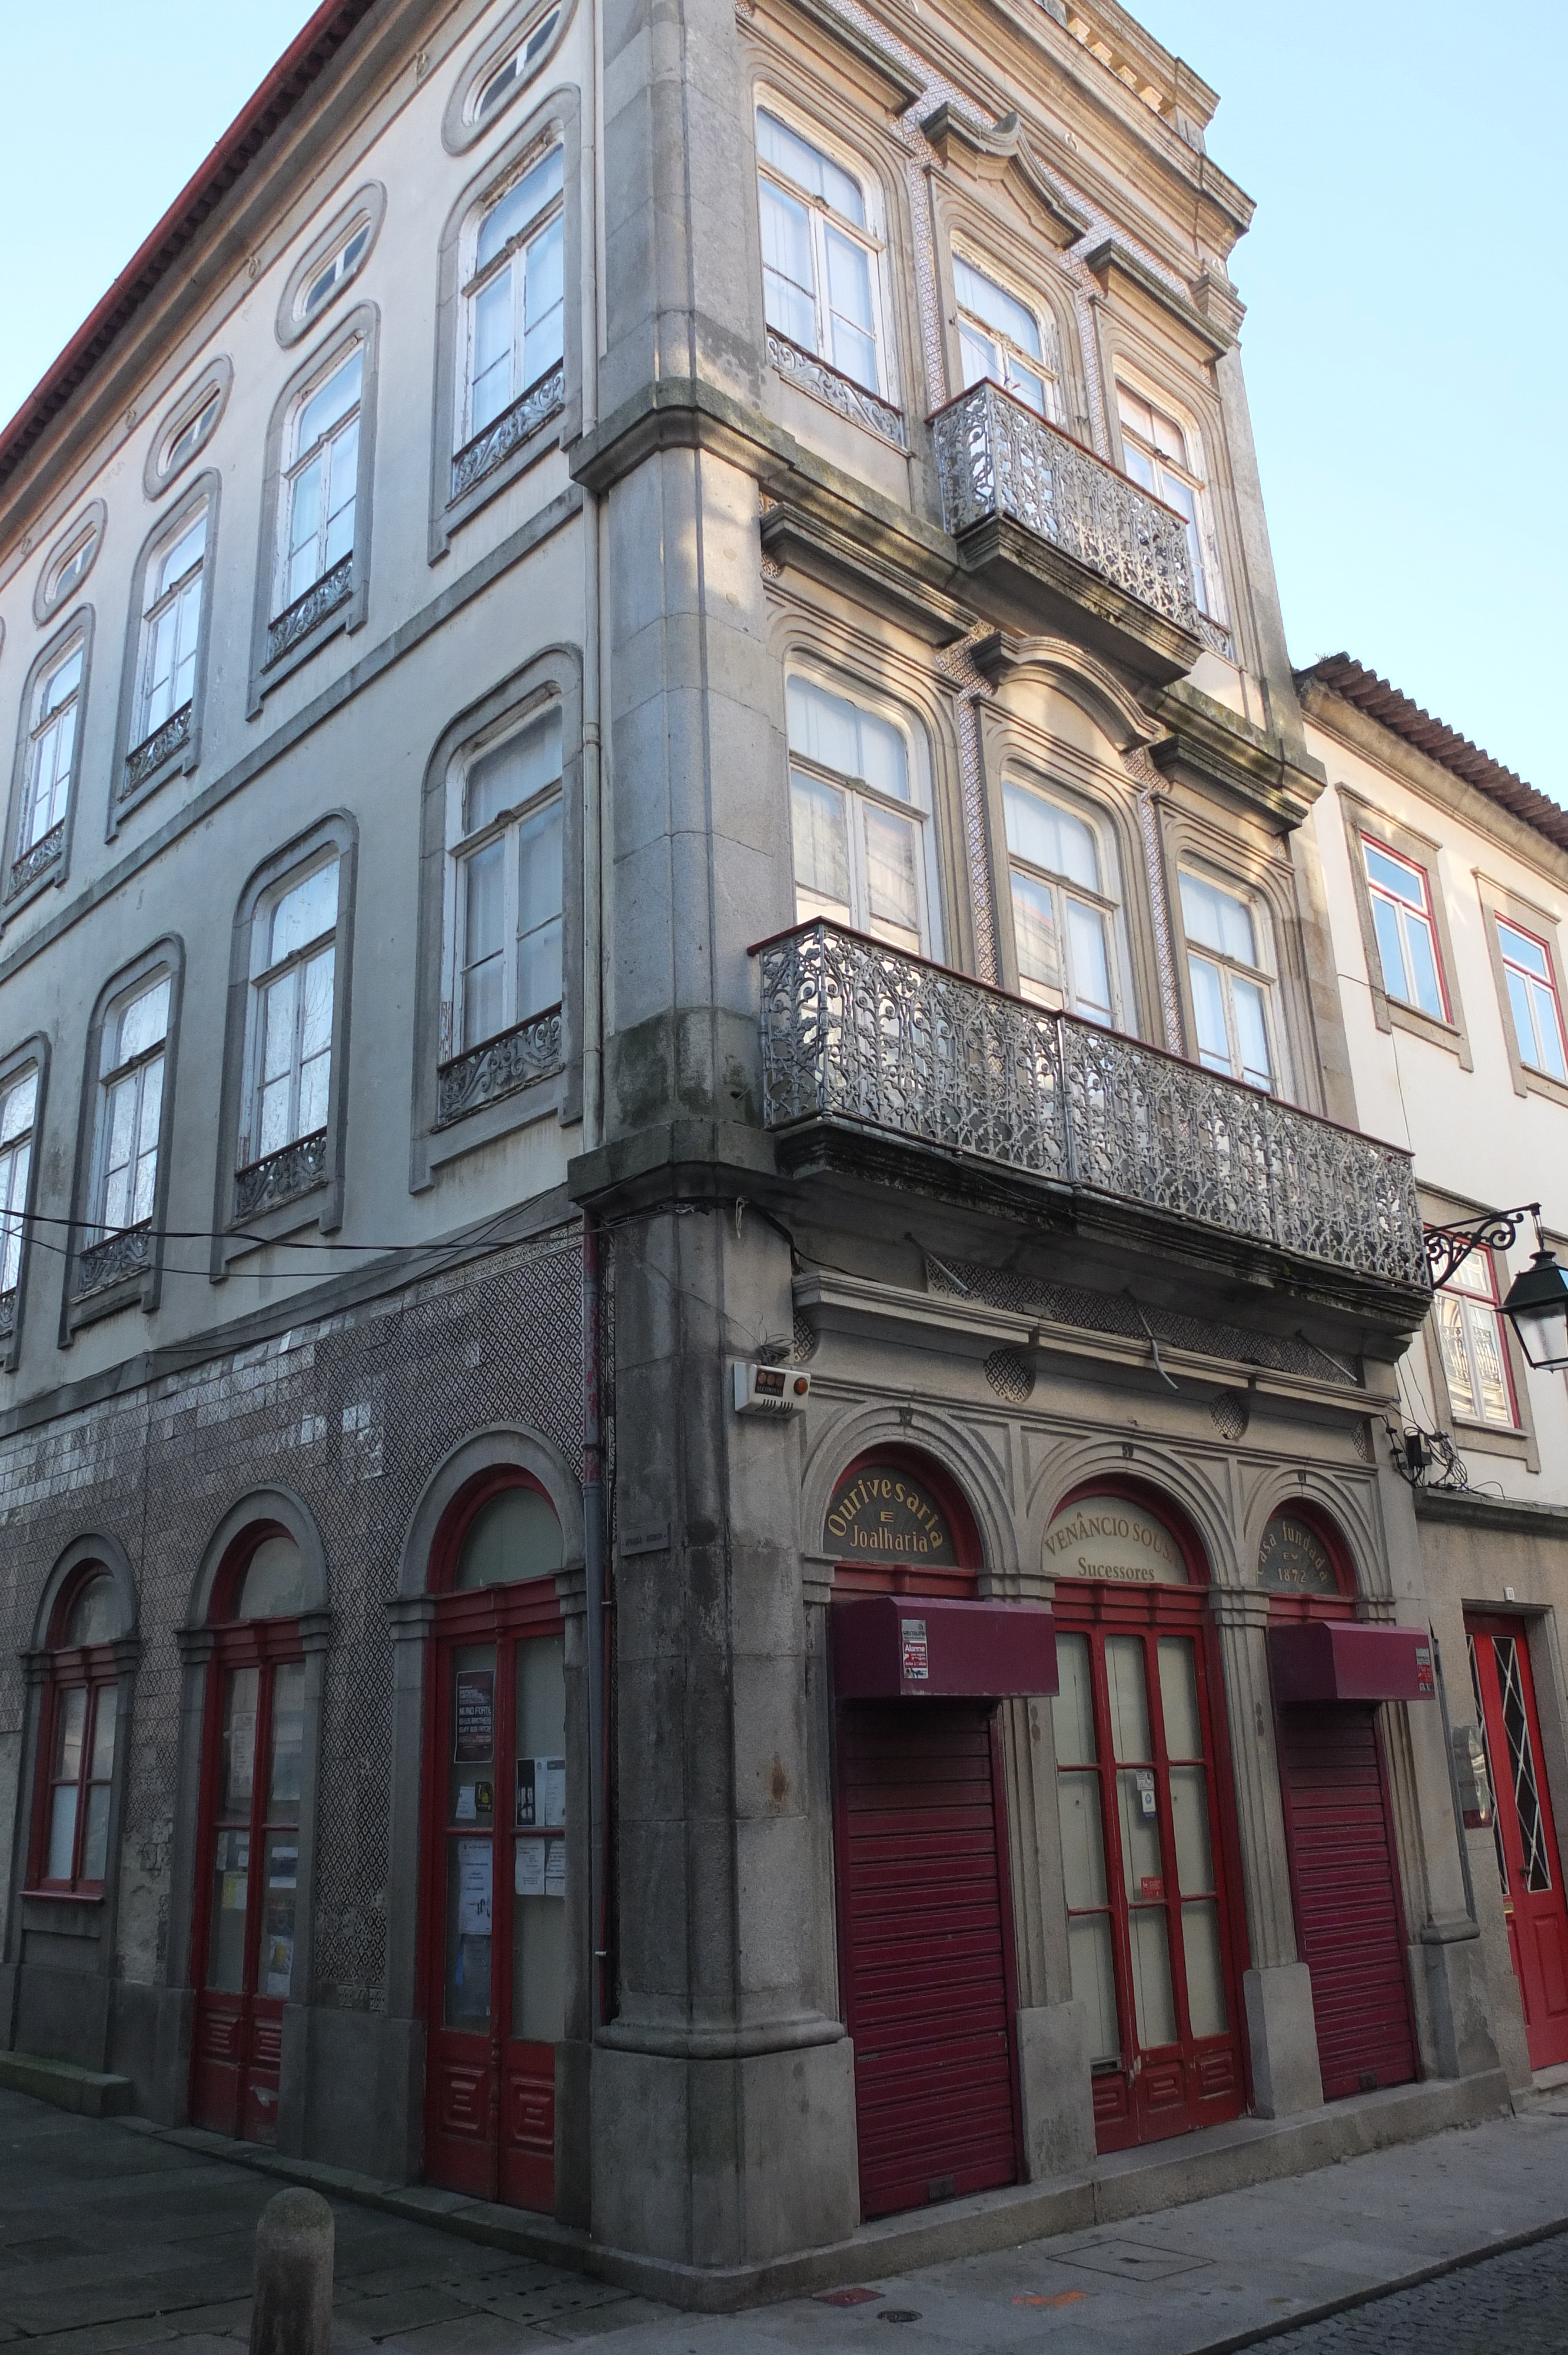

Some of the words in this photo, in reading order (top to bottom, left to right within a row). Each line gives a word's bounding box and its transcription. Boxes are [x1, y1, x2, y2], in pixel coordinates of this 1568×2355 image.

[828, 1479, 944, 1550] Ourivesaria
[880, 1511, 894, 1523] E
[849, 1525, 928, 1553] Joalharia
[1044, 1512, 1130, 1556] VENÂNCIO
[1283, 1521, 1327, 1582] fundada
[1283, 1552, 1298, 1560] EM
[1078, 1557, 1155, 1581] Sucessores
[1278, 1567, 1307, 1583] 1872
[905, 1644, 925, 1653] Alarme
